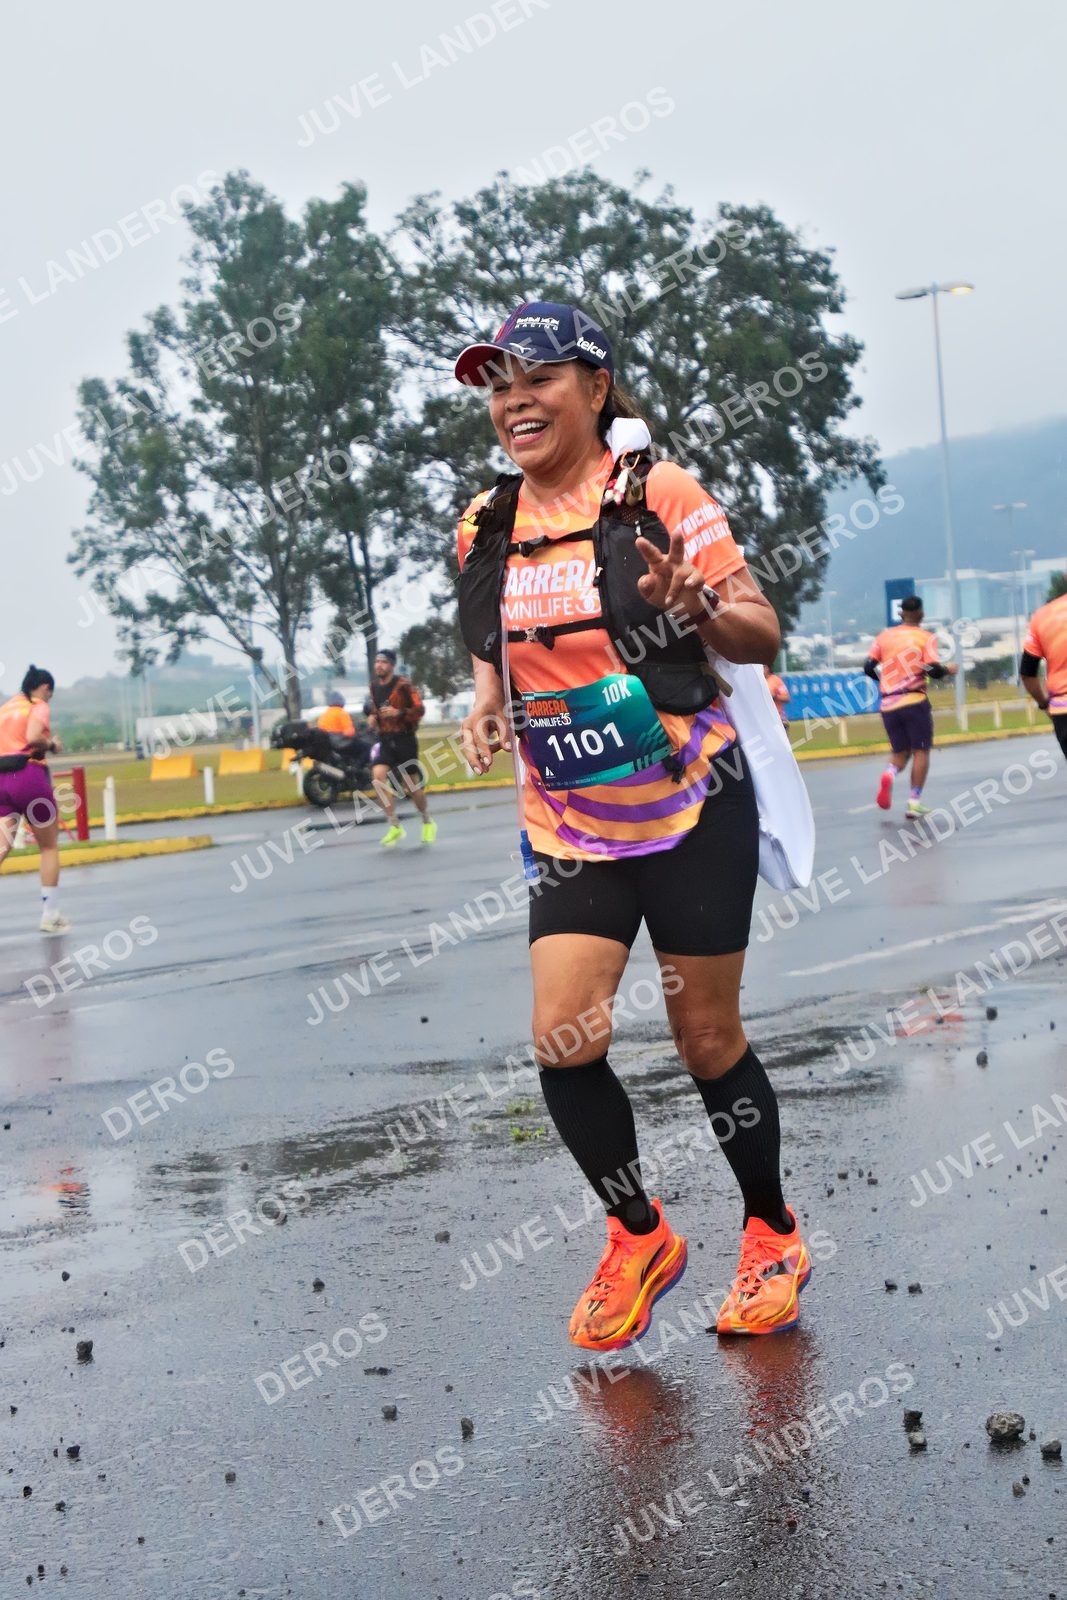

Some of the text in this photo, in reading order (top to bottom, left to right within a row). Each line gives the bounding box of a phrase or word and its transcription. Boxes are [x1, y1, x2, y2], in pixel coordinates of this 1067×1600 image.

[576, 336, 607, 359] telcel
[503, 558, 597, 598] ARRER
[503, 596, 574, 620] MNILIFE
[601, 677, 632, 706] 10K
[526, 698, 569, 717] CARRERA
[546, 721, 625, 762] 1101
